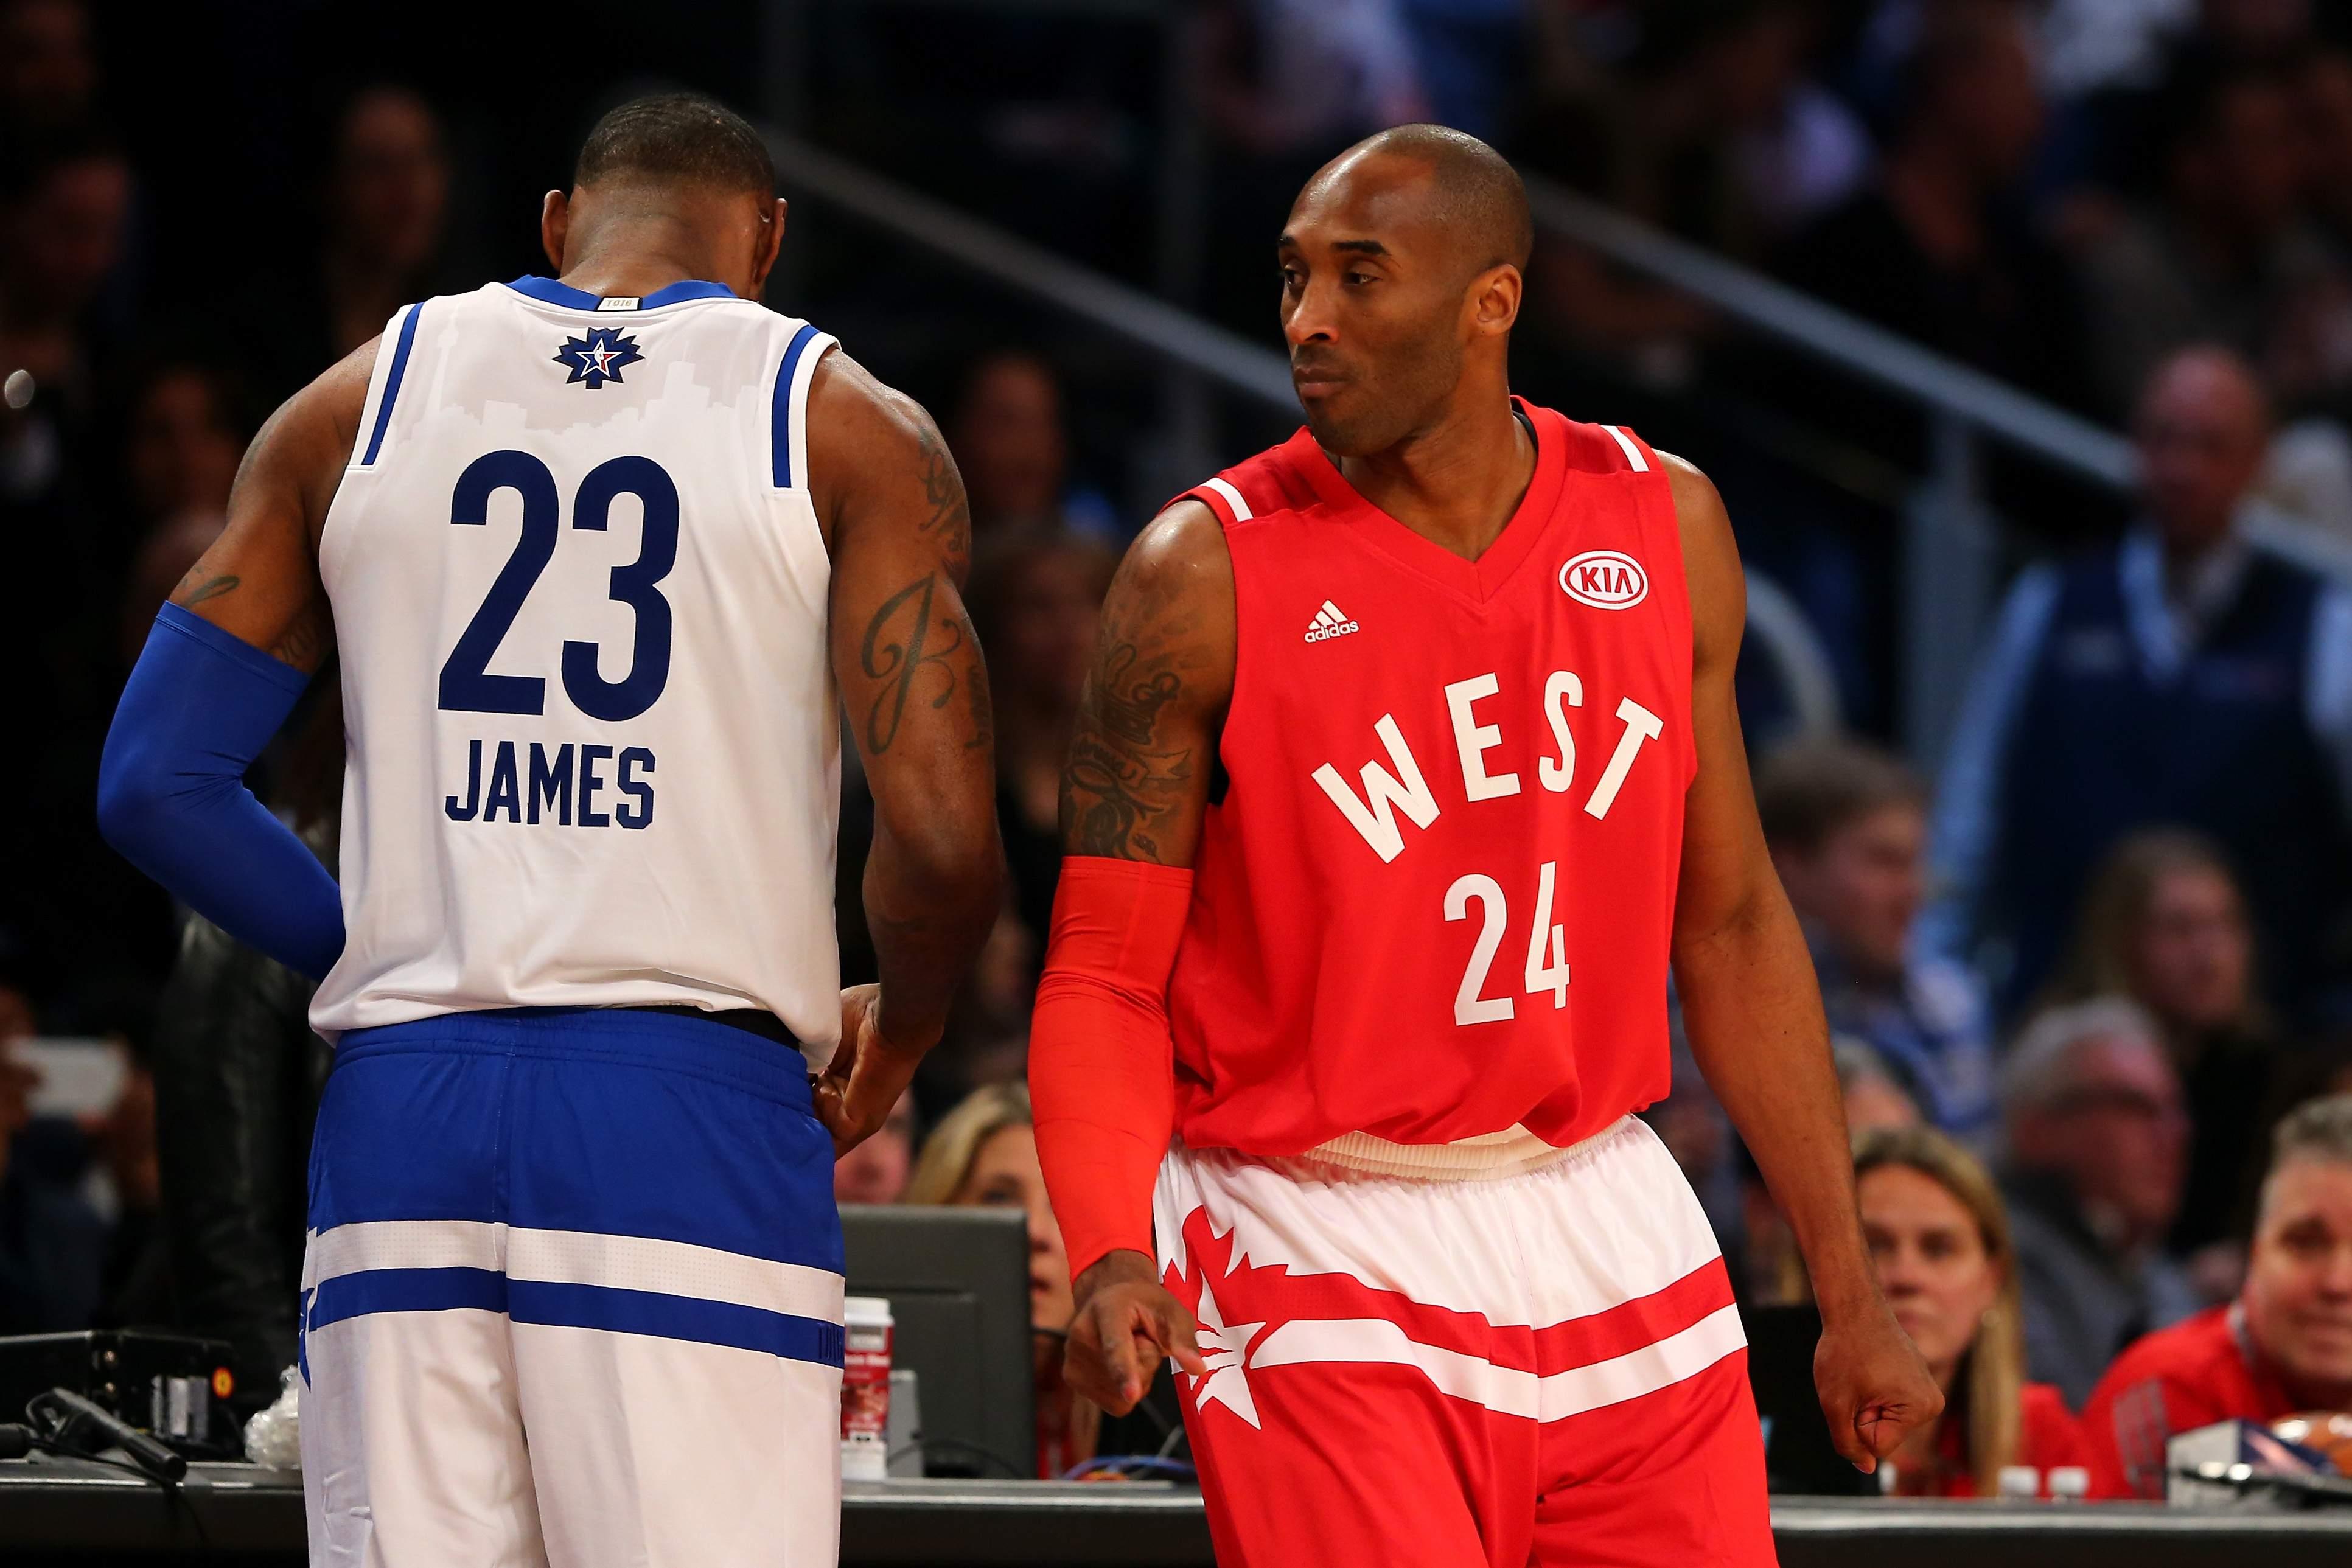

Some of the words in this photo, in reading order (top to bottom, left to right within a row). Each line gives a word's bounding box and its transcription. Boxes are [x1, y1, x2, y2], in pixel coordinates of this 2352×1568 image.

[438, 450, 680, 722] 23
[1304, 621, 1360, 643] adidas
[1579, 566, 1633, 594] KIA
[444, 739, 656, 830] JAMES
[1311, 671, 1664, 864] WEST
[1443, 861, 1570, 1026] 24
